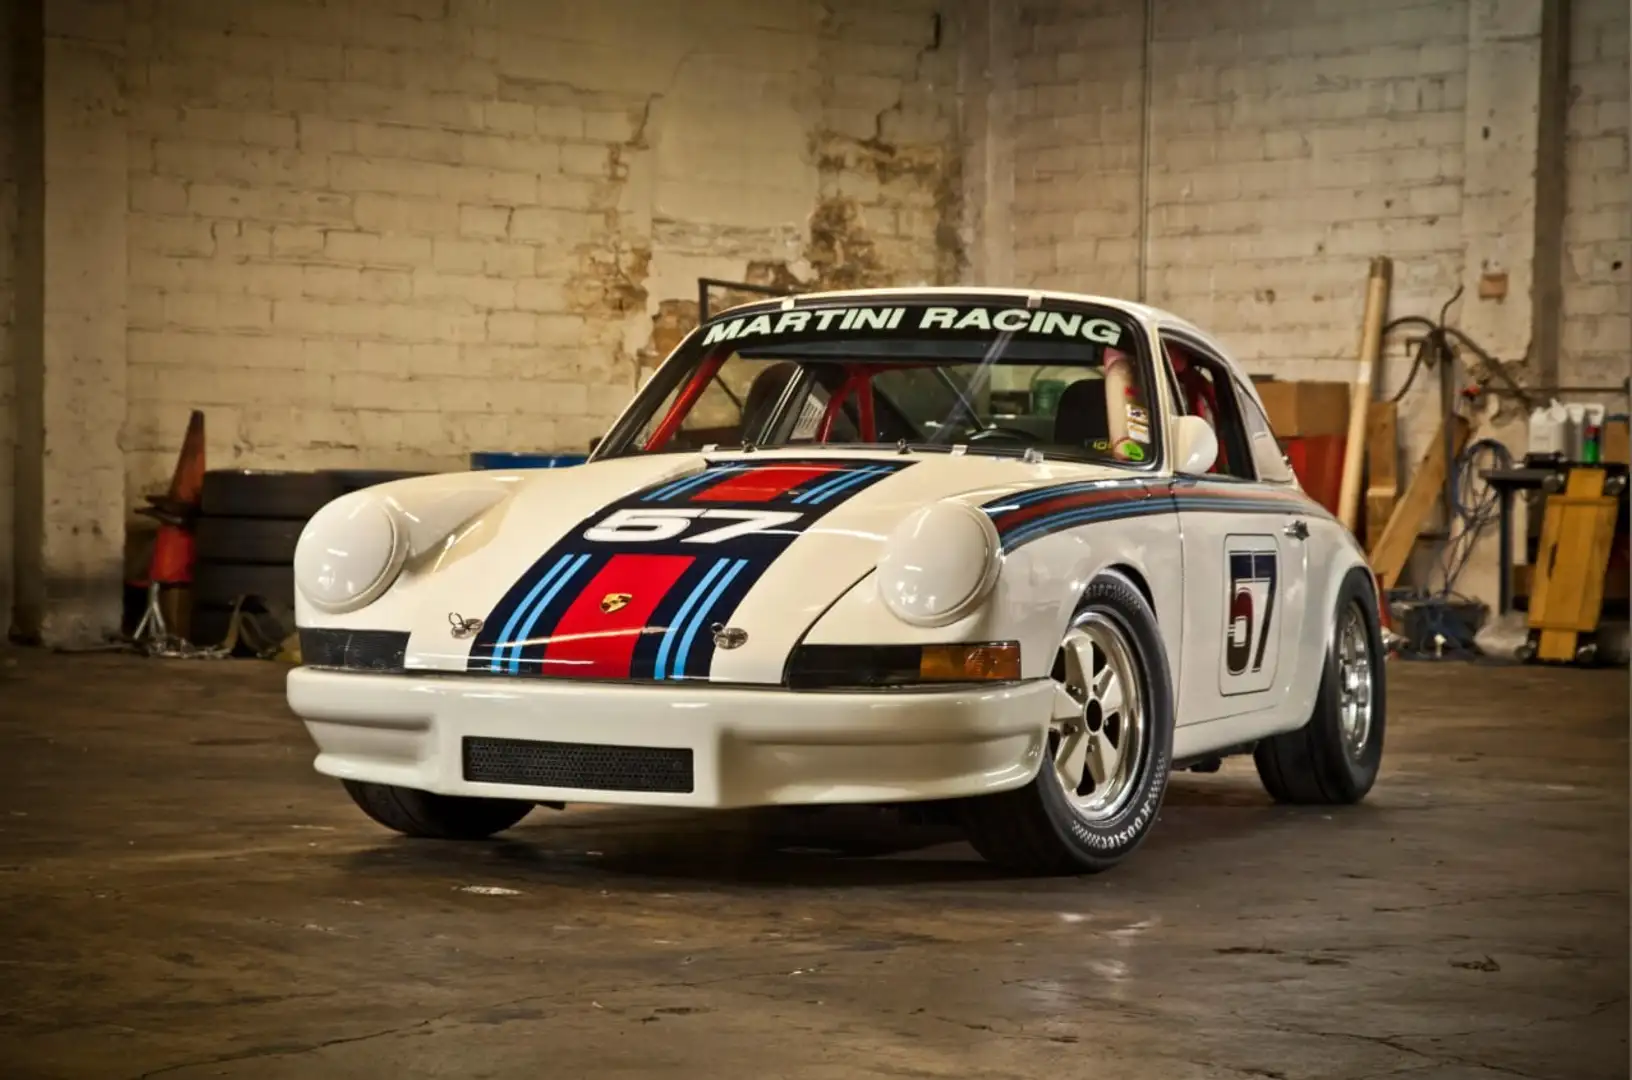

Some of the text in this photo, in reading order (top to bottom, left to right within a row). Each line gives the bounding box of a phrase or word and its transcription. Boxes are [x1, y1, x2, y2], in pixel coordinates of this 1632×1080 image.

[701, 307, 1123, 347] MARTINI RACING
[582, 508, 805, 544] 57
[1227, 550, 1278, 676] 57
